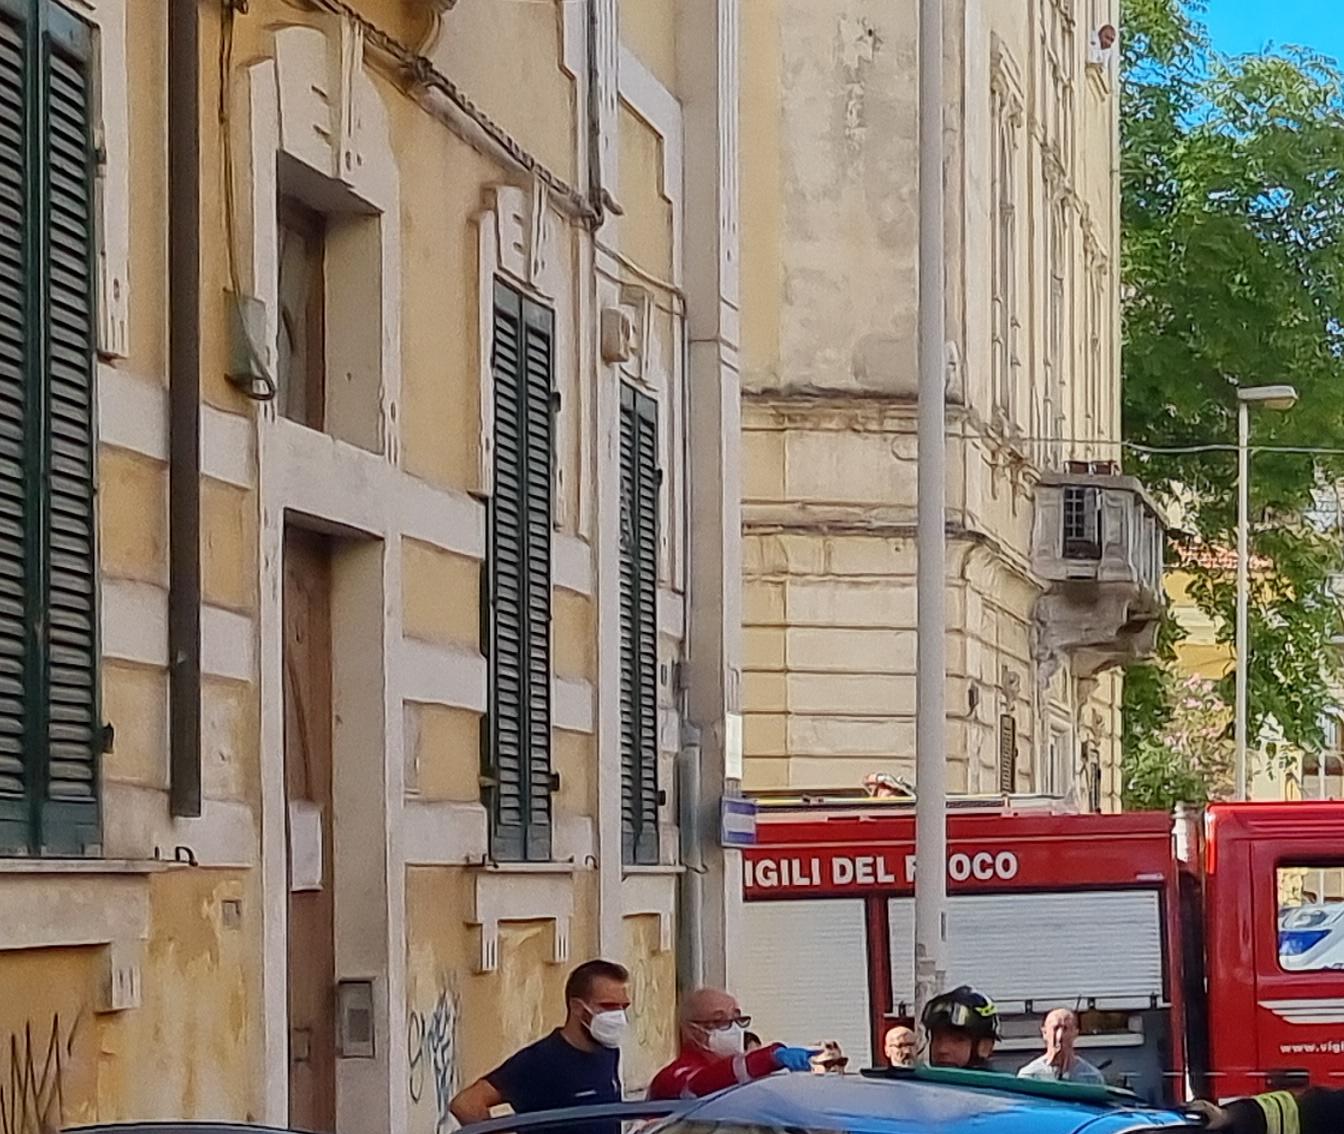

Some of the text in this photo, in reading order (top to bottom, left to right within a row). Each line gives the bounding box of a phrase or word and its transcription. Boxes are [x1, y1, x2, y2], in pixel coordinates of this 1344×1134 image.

[745, 851, 1018, 887] IGILI DEL FOCO
